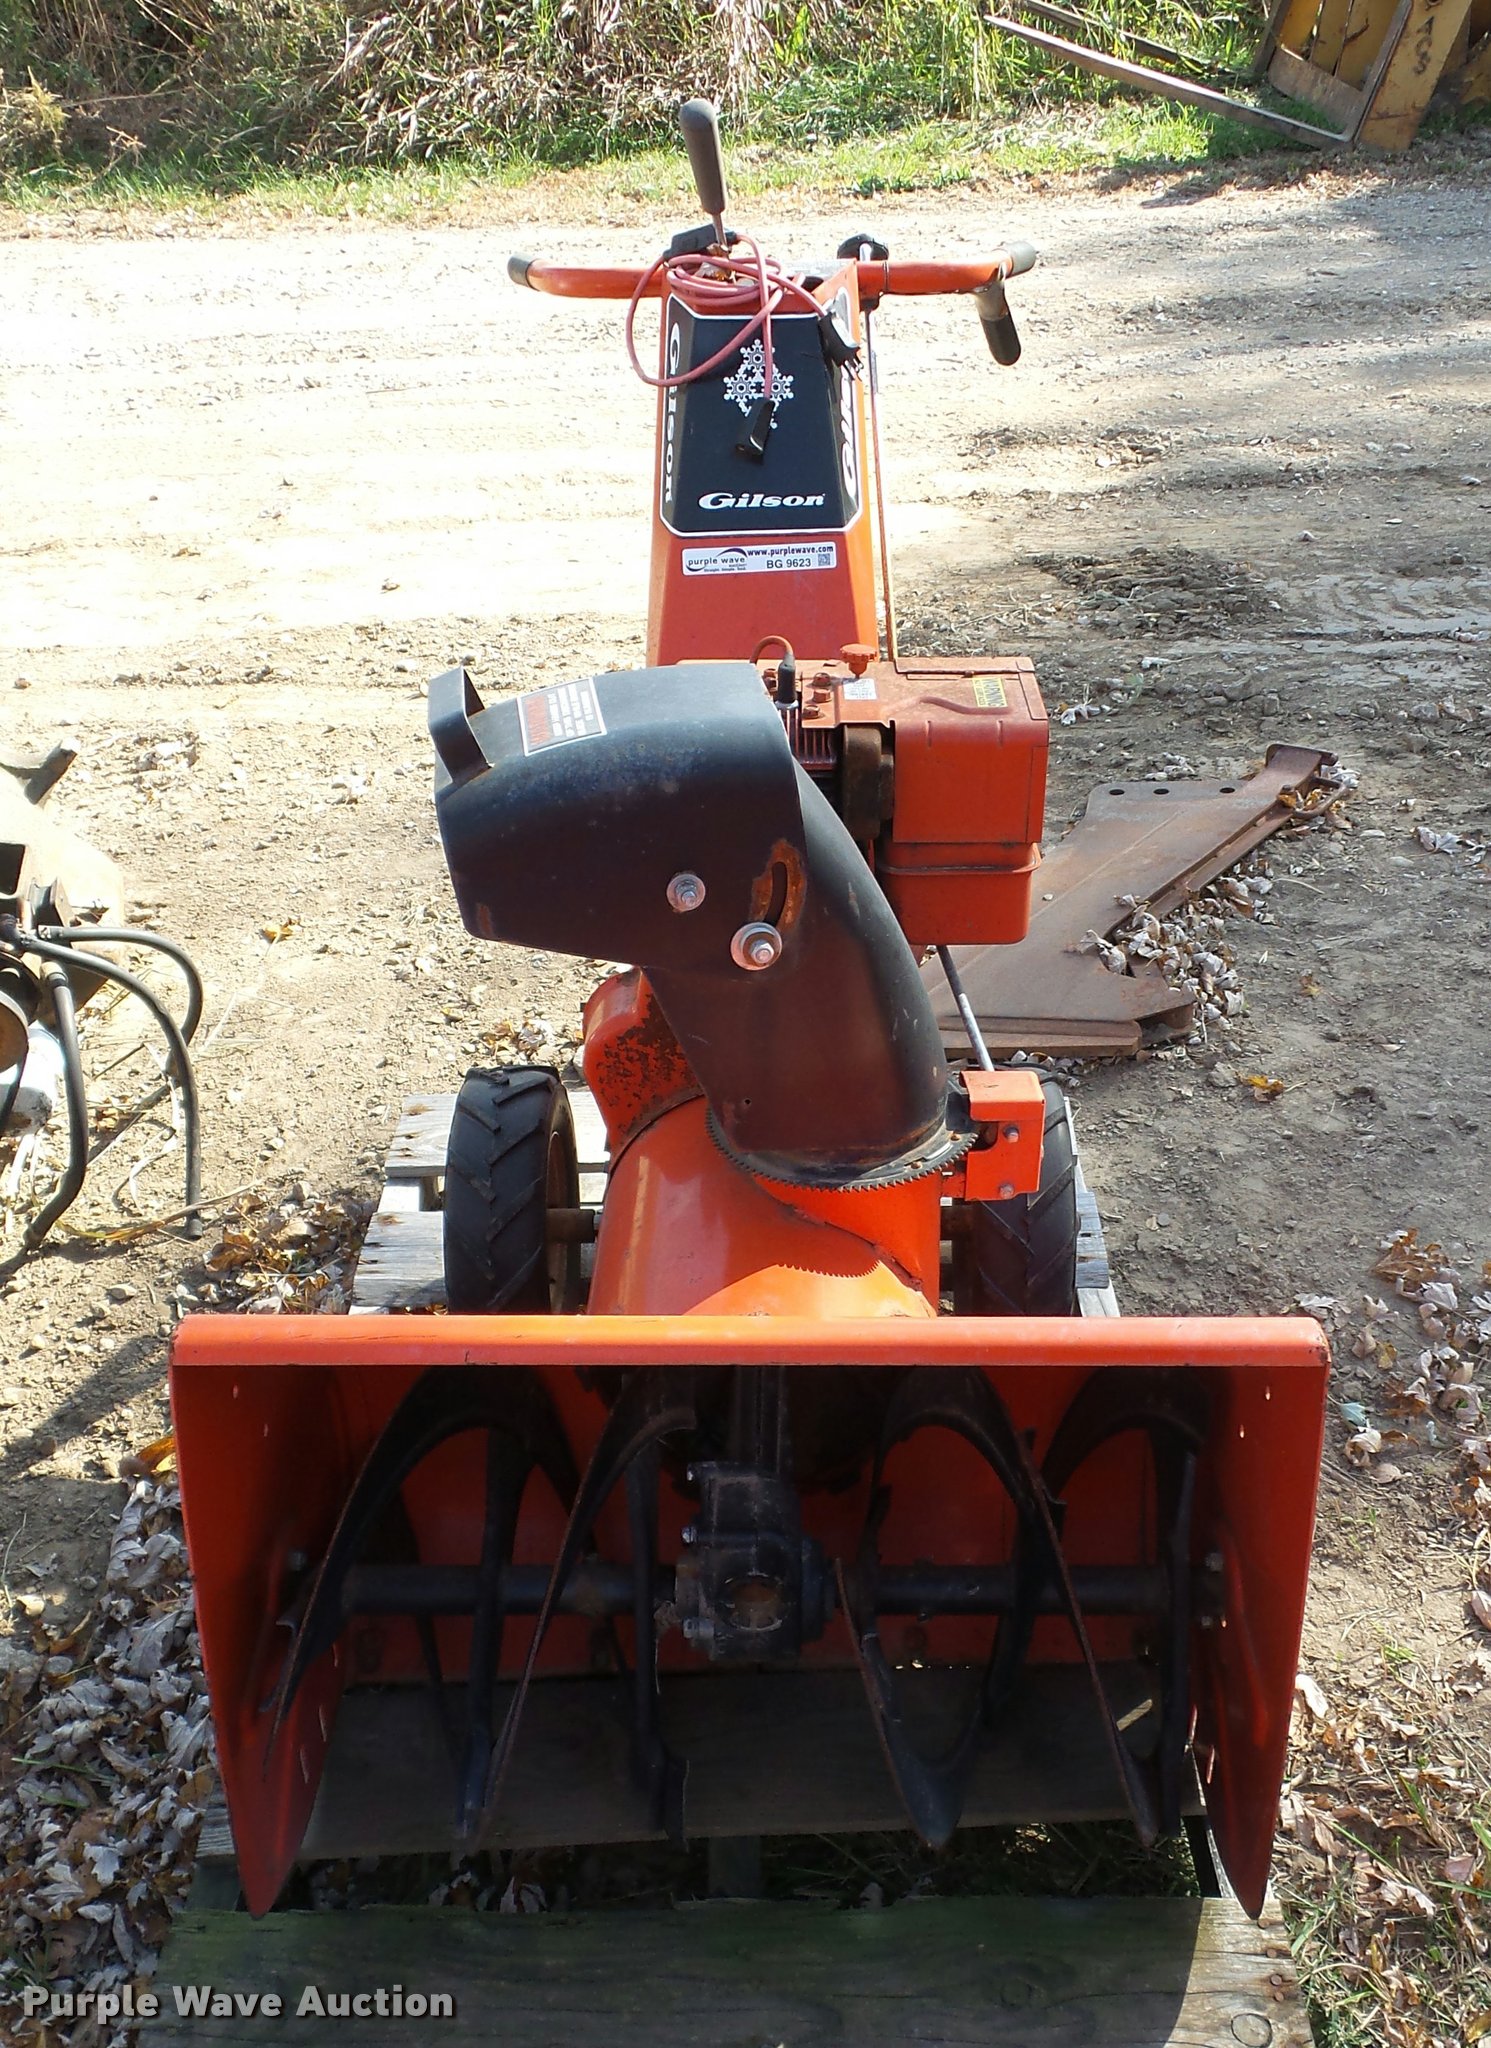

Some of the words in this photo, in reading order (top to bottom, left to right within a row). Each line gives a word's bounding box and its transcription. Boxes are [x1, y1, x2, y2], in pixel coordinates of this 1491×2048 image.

[699, 492, 825, 510] Gilson
[747, 545, 834, 557] www.purplewave.com
[688, 557, 718, 566] purple
[766, 559, 783, 569] BG
[786, 558, 812, 568] 9623
